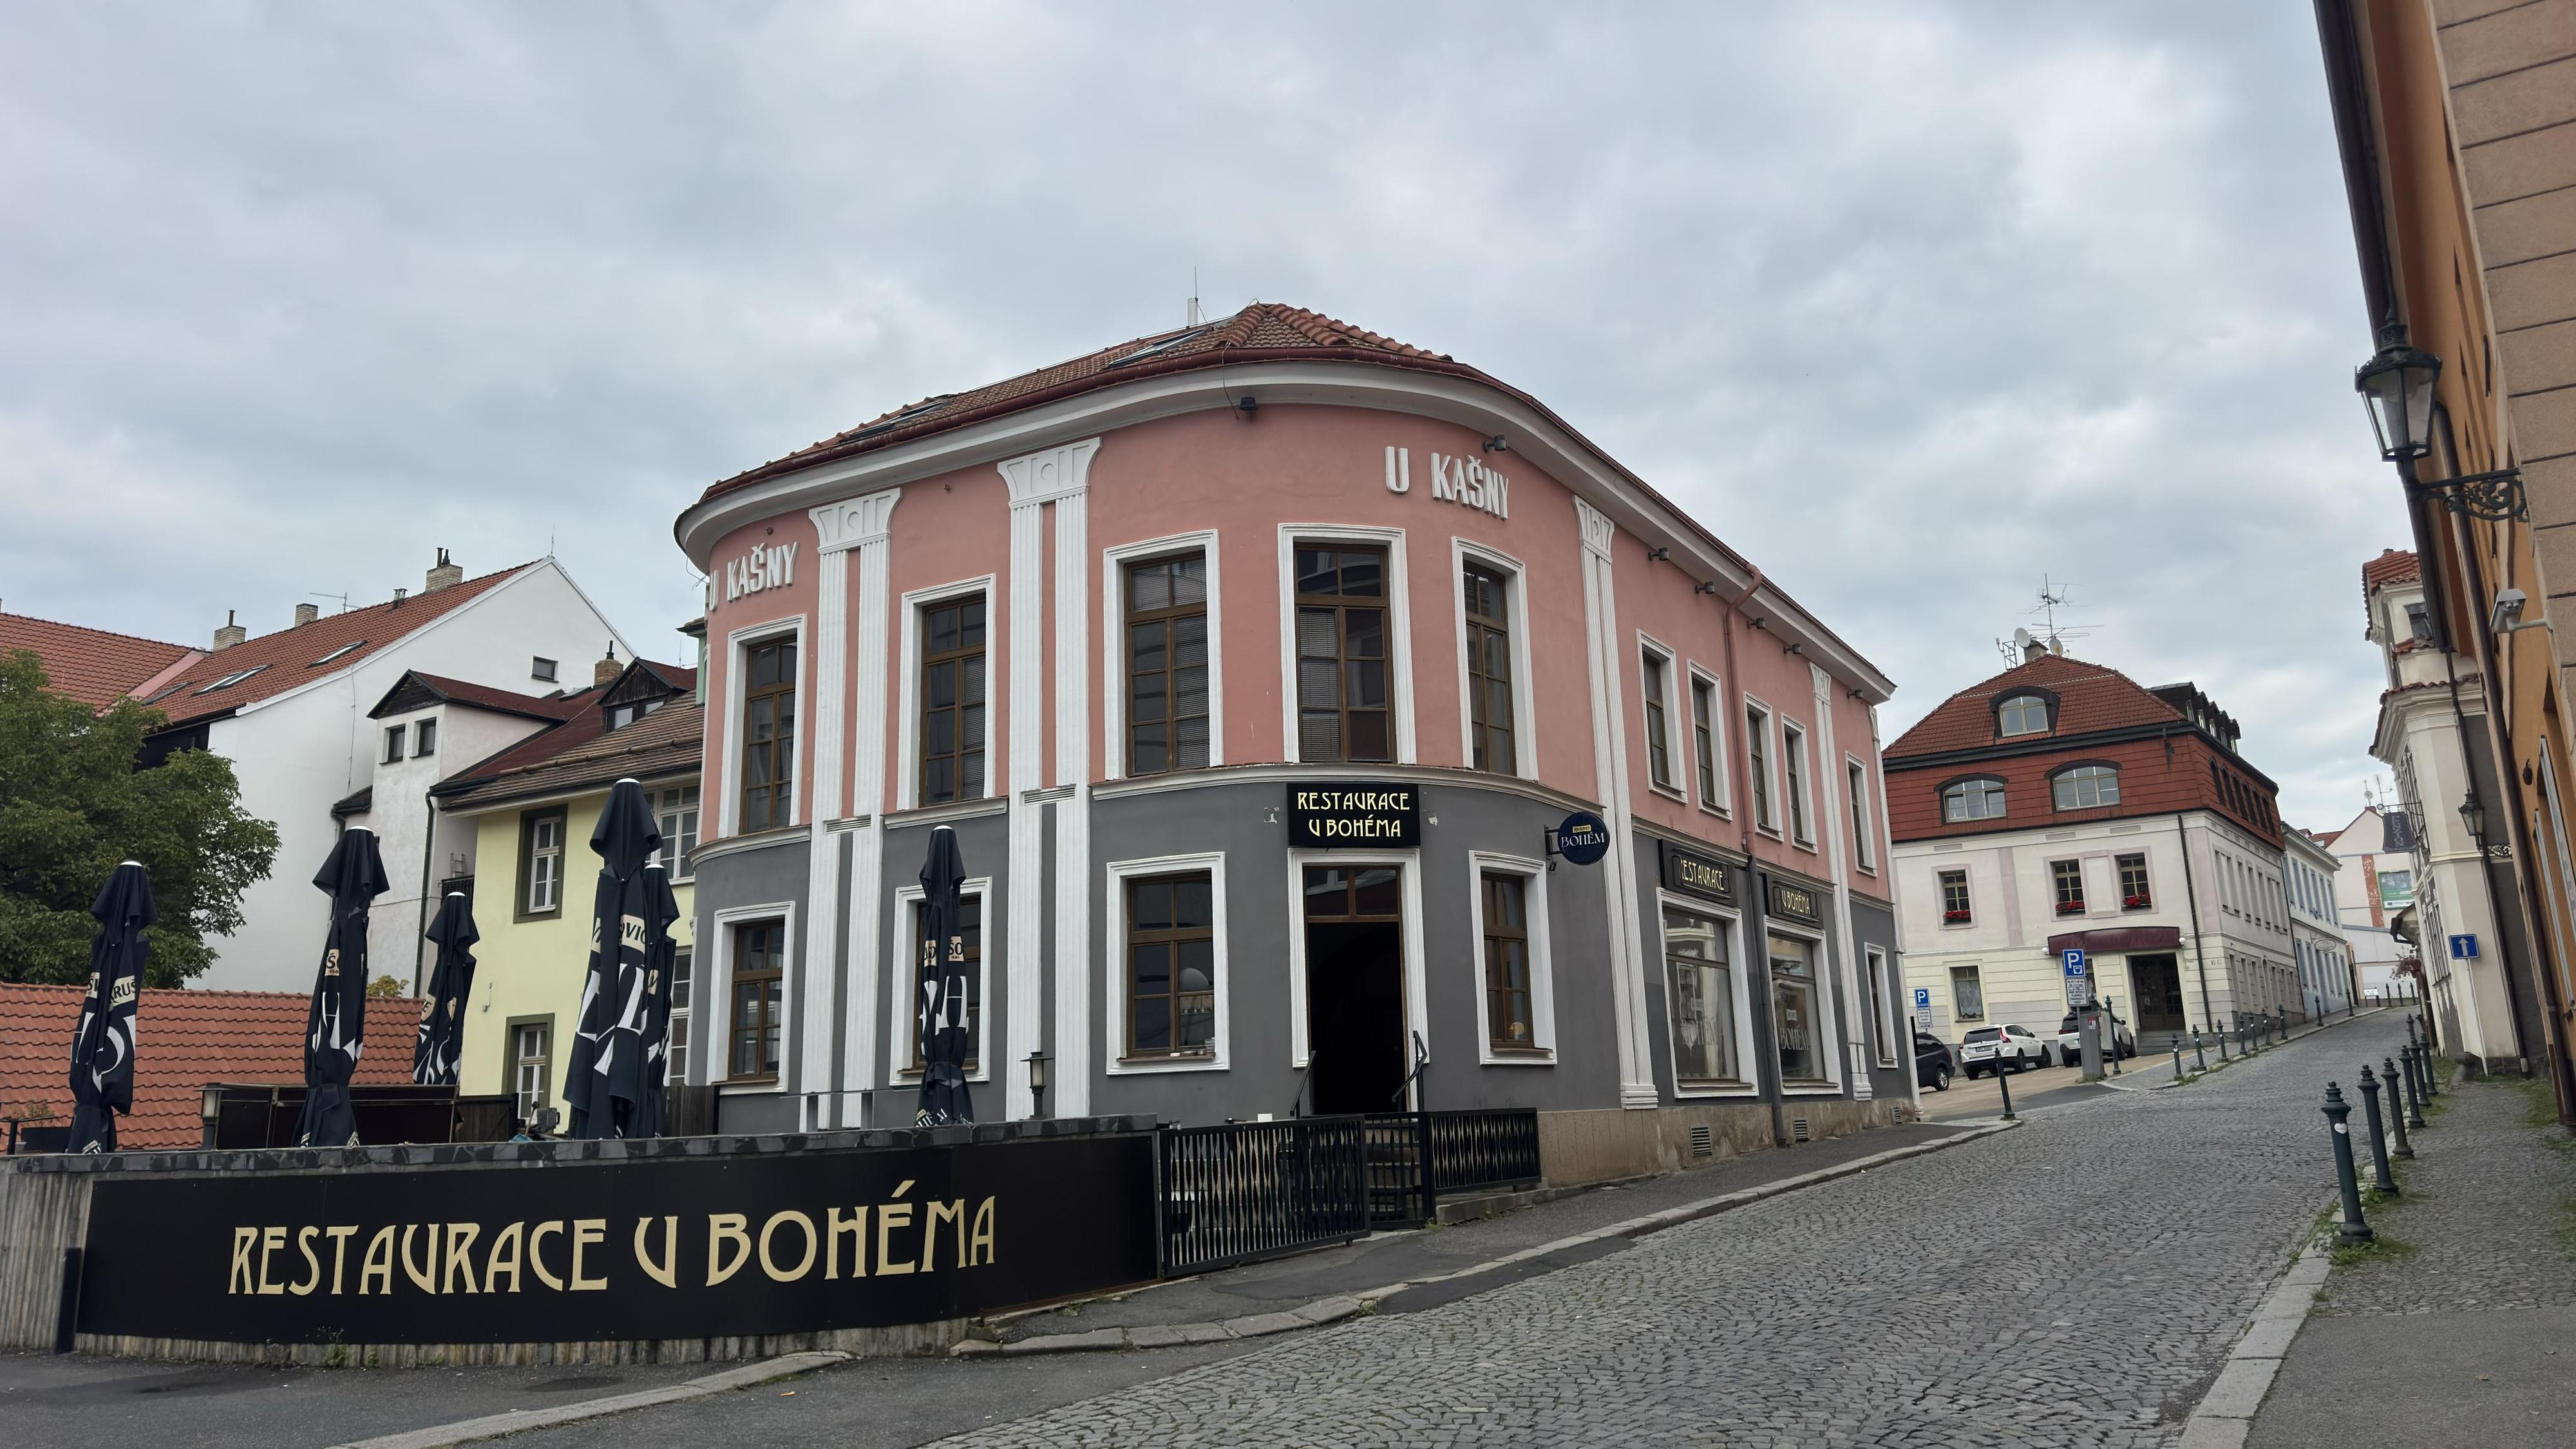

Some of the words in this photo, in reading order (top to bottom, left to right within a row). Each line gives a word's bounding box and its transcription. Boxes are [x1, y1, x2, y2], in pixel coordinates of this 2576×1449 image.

[1385, 446, 1410, 493] U
[1431, 453, 1509, 520] KAŠNY
[709, 570, 719, 611] U
[726, 541, 799, 603] KAŠNY
[1297, 792, 1410, 810] RESTAURACE
[1308, 819, 1320, 837] U
[1326, 814, 1401, 837] BOHÉMA
[1561, 831, 1605, 848] BOHÉM
[1787, 891, 1810, 914] BOHÉMA
[2067, 952, 2079, 969] P
[1917, 991, 1926, 1003] P
[228, 1219, 607, 1295] RESTAURACE
[634, 1216, 678, 1288] U
[706, 1180, 995, 1287] BOHÉMA
